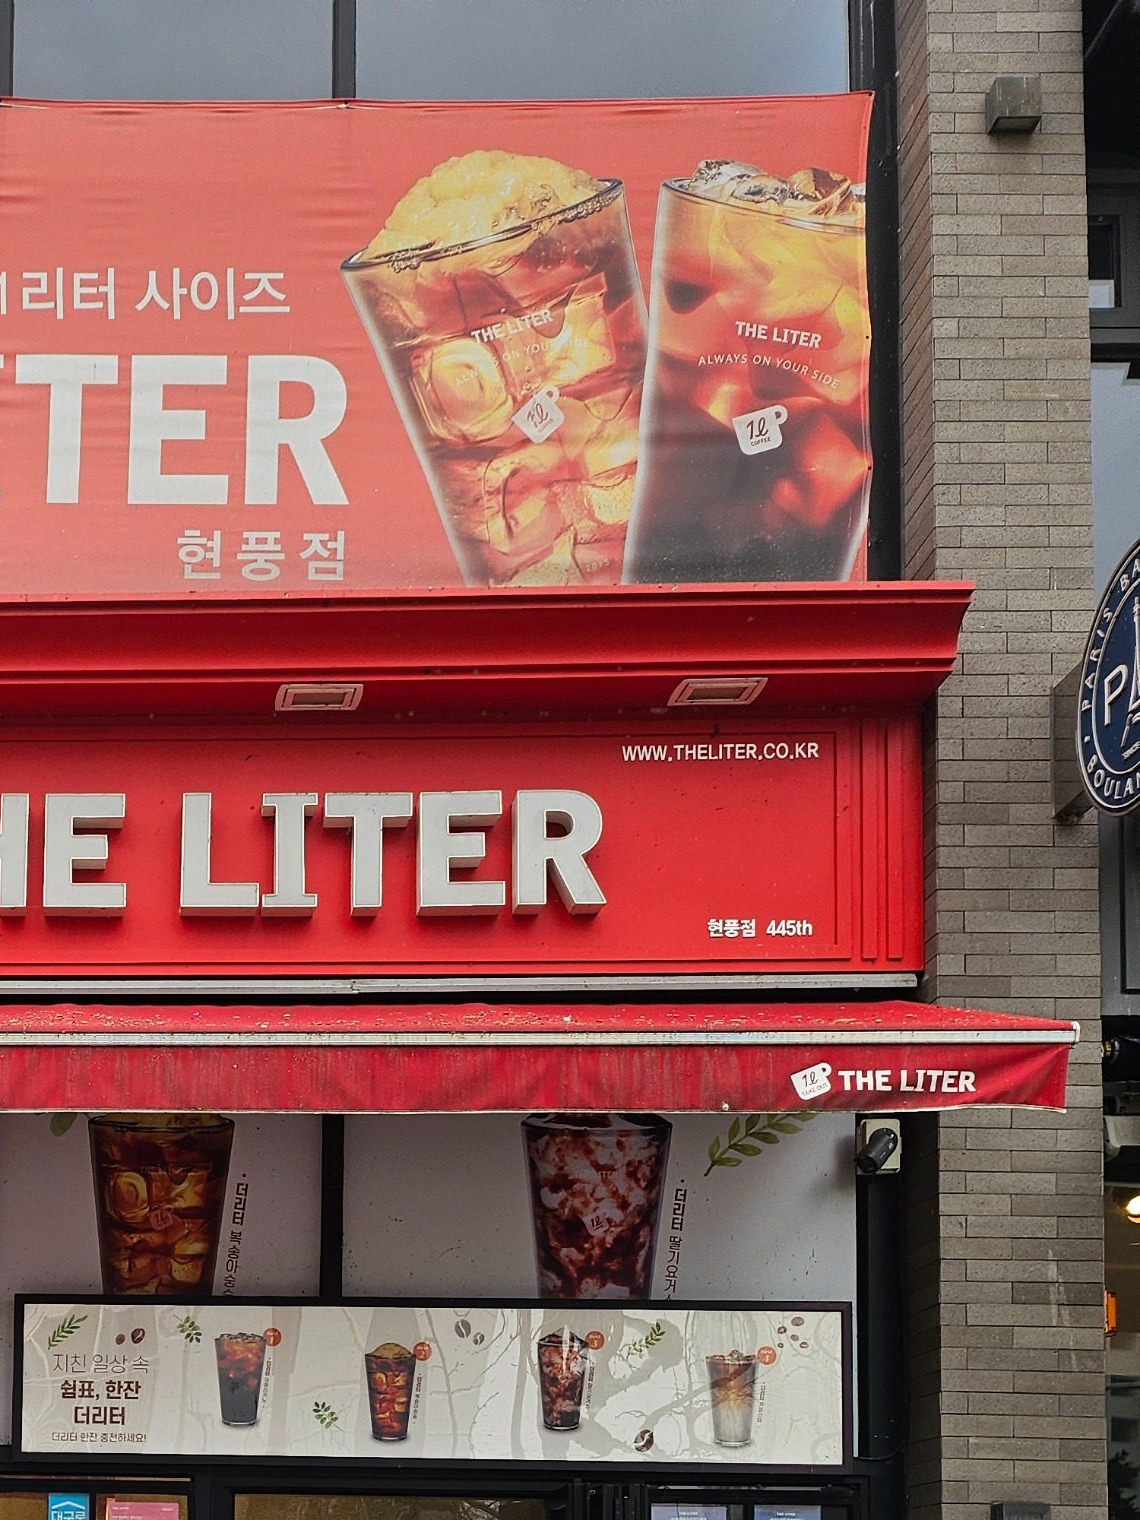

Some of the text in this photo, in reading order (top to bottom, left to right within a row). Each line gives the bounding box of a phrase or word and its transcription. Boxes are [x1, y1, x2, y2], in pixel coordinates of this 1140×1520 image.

[137, 267, 290, 321] 사이즈
[470, 309, 554, 346] THE LITER
[735, 320, 823, 349] THE LITER
[698, 353, 841, 390] ALWAYS ON YOUR SIDE
[176, 529, 347, 581] 현풍점
[621, 741, 820, 763] WWW.THELITER.CO.KR
[178, 789, 607, 918] LITER
[707, 918, 813, 938] 현풍점 445th
[838, 1069, 977, 1093] THE LITER
[231, 1182, 249, 1227] 더리터
[670, 1188, 688, 1232] 더리터
[52, 1352, 150, 1375] 지친 일상 속
[60, 1380, 141, 1401] 쉼표, 한잔
[73, 1406, 126, 1426] 더리터
